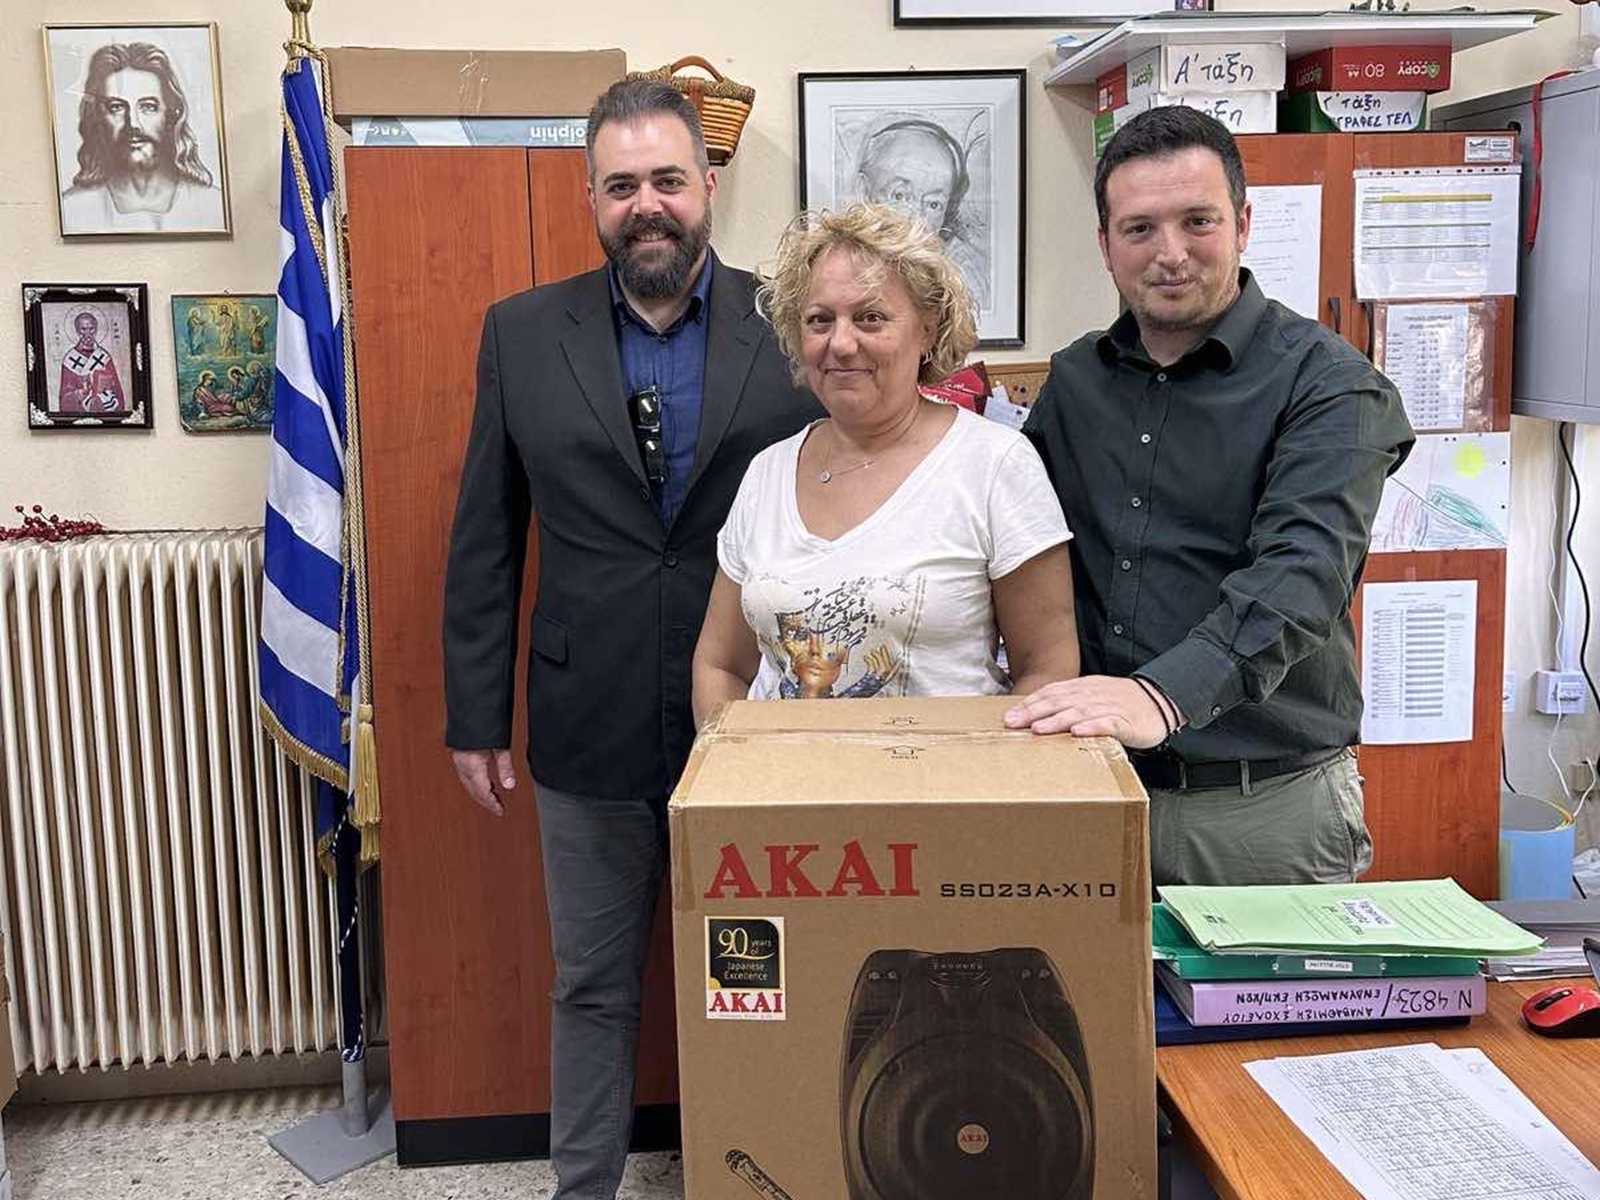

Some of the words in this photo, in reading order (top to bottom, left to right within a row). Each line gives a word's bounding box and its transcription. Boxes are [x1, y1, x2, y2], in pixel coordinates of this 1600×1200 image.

[1174, 52, 1199, 84] Α'
[1201, 52, 1253, 83] τάξη
[1365, 63, 1385, 78] 80
[1398, 64, 1428, 75] COPY
[1341, 94, 1381, 111] τάξη
[1203, 99, 1243, 126] άξη
[1333, 115, 1382, 128] ΓΡΑΦΕΣ
[531, 125, 586, 142] olphin
[703, 840, 920, 899] AKAI
[940, 882, 1117, 898] SS023A-X10
[718, 927, 748, 957] 90
[751, 939, 772, 948] years
[727, 961, 765, 971] Japanese
[724, 970, 769, 980] Excellence
[708, 991, 783, 1013] AKAI
[1295, 989, 1381, 1003] ΕΝΔΥΝΑΜΩΣΗ
[1222, 1010, 1290, 1024] ΣΧΟΛΕΙΟΥ
[1296, 1007, 1373, 1020] ΑΝΑΒΑΘΜΙΣΗ
